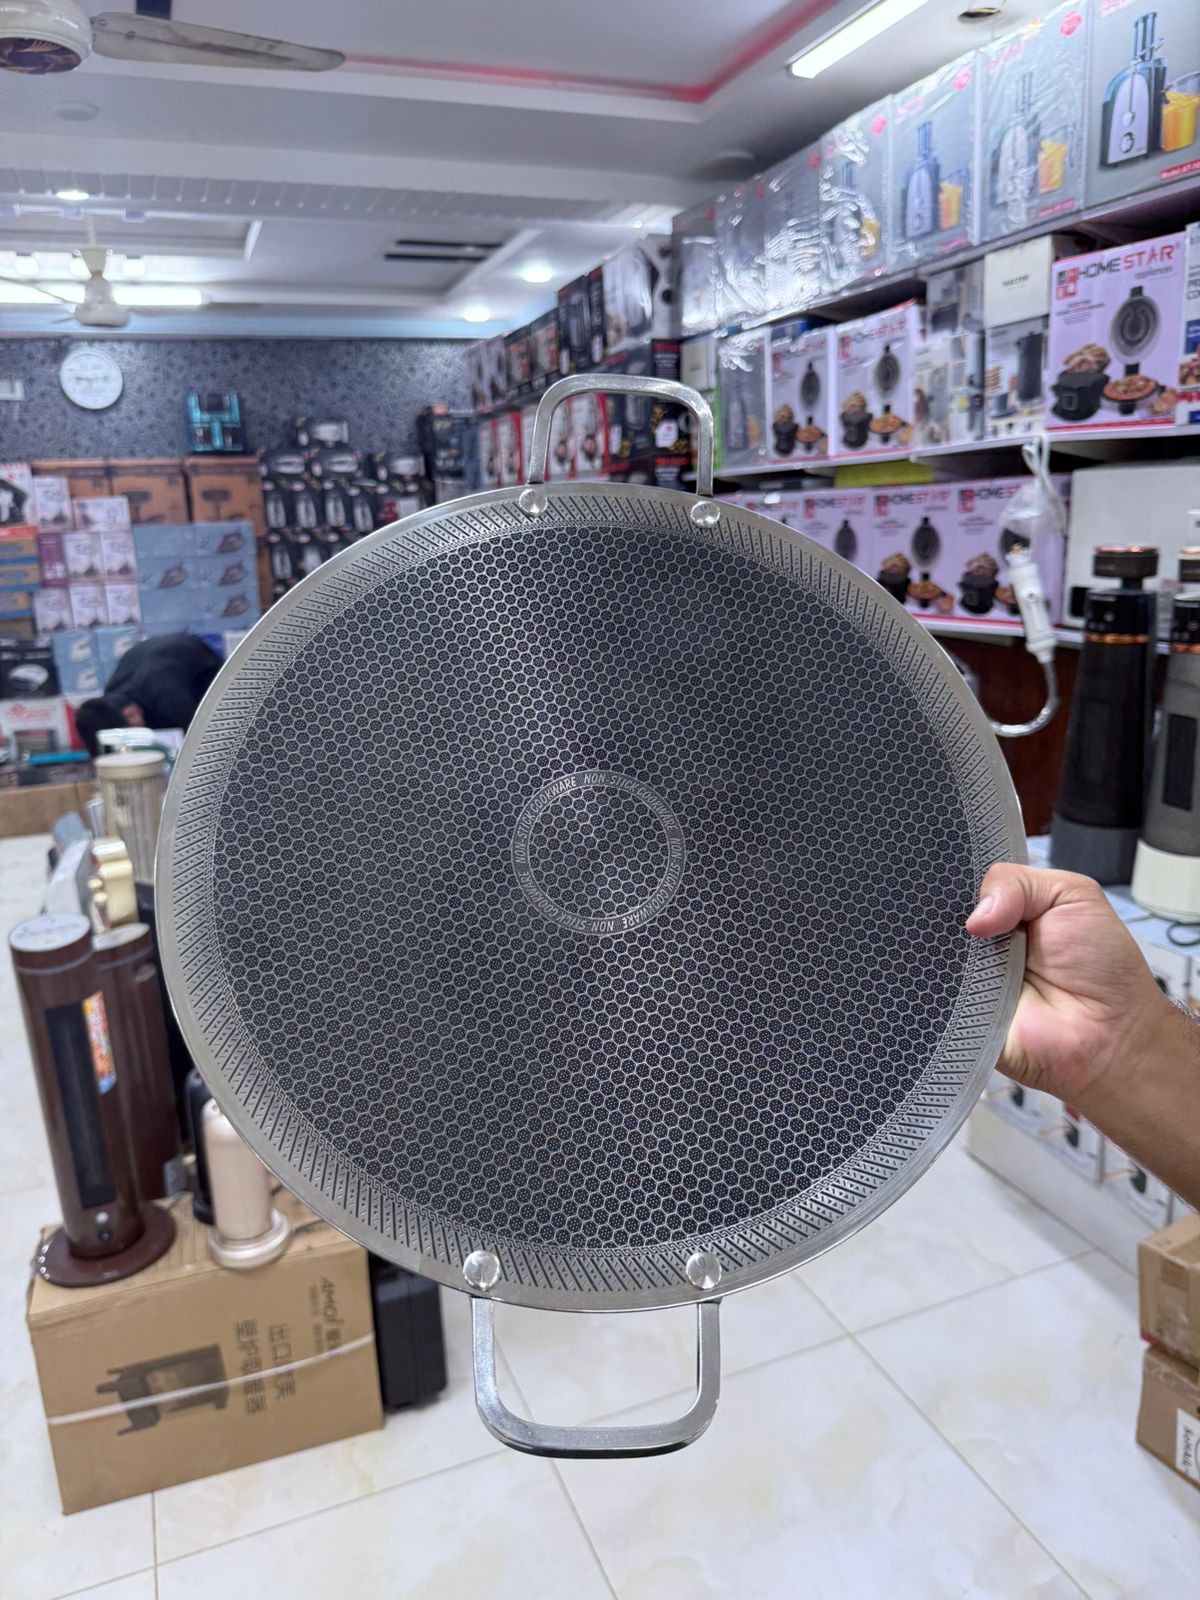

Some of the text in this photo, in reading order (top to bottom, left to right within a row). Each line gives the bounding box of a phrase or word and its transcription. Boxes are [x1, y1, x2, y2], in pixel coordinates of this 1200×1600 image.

[530, 776, 577, 813] COOKWARE
[636, 787, 678, 830] COOKWARE
[555, 911, 614, 932] NON-STICK
[621, 889, 669, 929] COOKWARE
